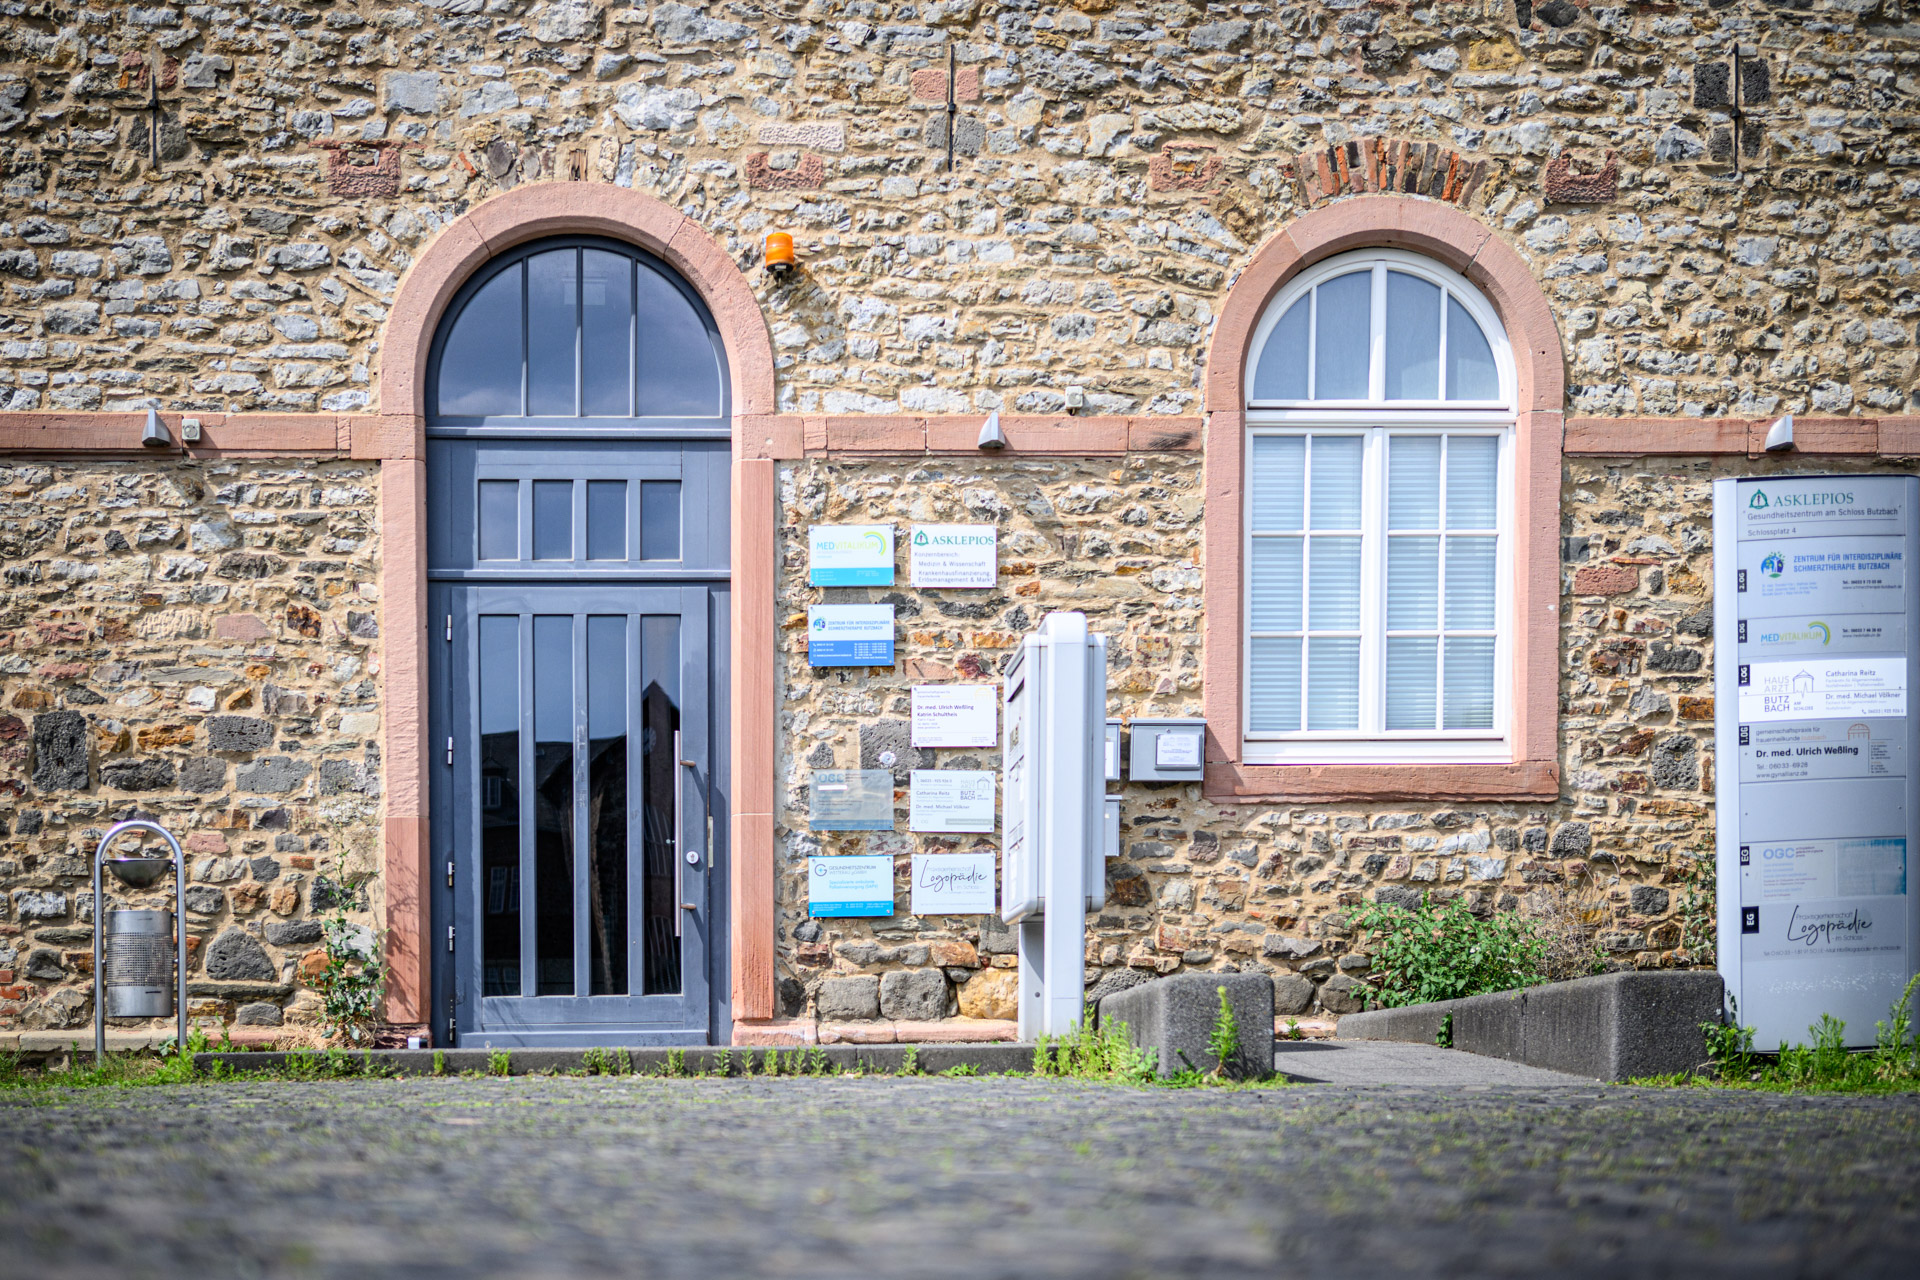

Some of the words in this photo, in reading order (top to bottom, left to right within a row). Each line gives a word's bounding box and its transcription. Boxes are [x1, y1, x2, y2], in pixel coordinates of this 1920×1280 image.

[1773, 492, 1854, 507] ASKLEPIOS
[1747, 510, 1823, 521] Gesundheitszentrum
[1838, 507, 1865, 516] Schloss
[1866, 508, 1898, 516] Butzbach
[1747, 528, 1790, 537] Schlossplatz
[816, 541, 879, 551] MEDVITALIKUM
[931, 535, 995, 546] ASKLEPIOS
[1793, 555, 1825, 563] ZENTRUM
[1827, 553, 1841, 562] FÜR
[1842, 552, 1902, 561] INTERDISZIPLINÄRE
[1793, 563, 1856, 573] SCHMERZTHERAPIE
[1857, 562, 1890, 571] BUTZBACH
[1760, 631, 1822, 643] MEDVITALIKUM
[1740, 666, 1748, 684] 1.OG
[1764, 676, 1789, 684] HAUS
[1764, 684, 1790, 693] ARZT
[1764, 695, 1790, 704] BUTZ
[1764, 704, 1790, 713] BACH
[1740, 726, 1748, 744] 1.OG
[1756, 750, 1768, 758] Dr.
[1771, 748, 1794, 757] med.
[1796, 747, 1822, 756] Ulrich
[1824, 745, 1859, 756] Weßling
[818, 773, 845, 783] OGC
[1741, 849, 1749, 862] EG
[1763, 847, 1795, 860] OGC
[919, 859, 988, 893] Logopädie
[1746, 913, 1755, 926] EG
[1787, 904, 1873, 946] Logopädie
